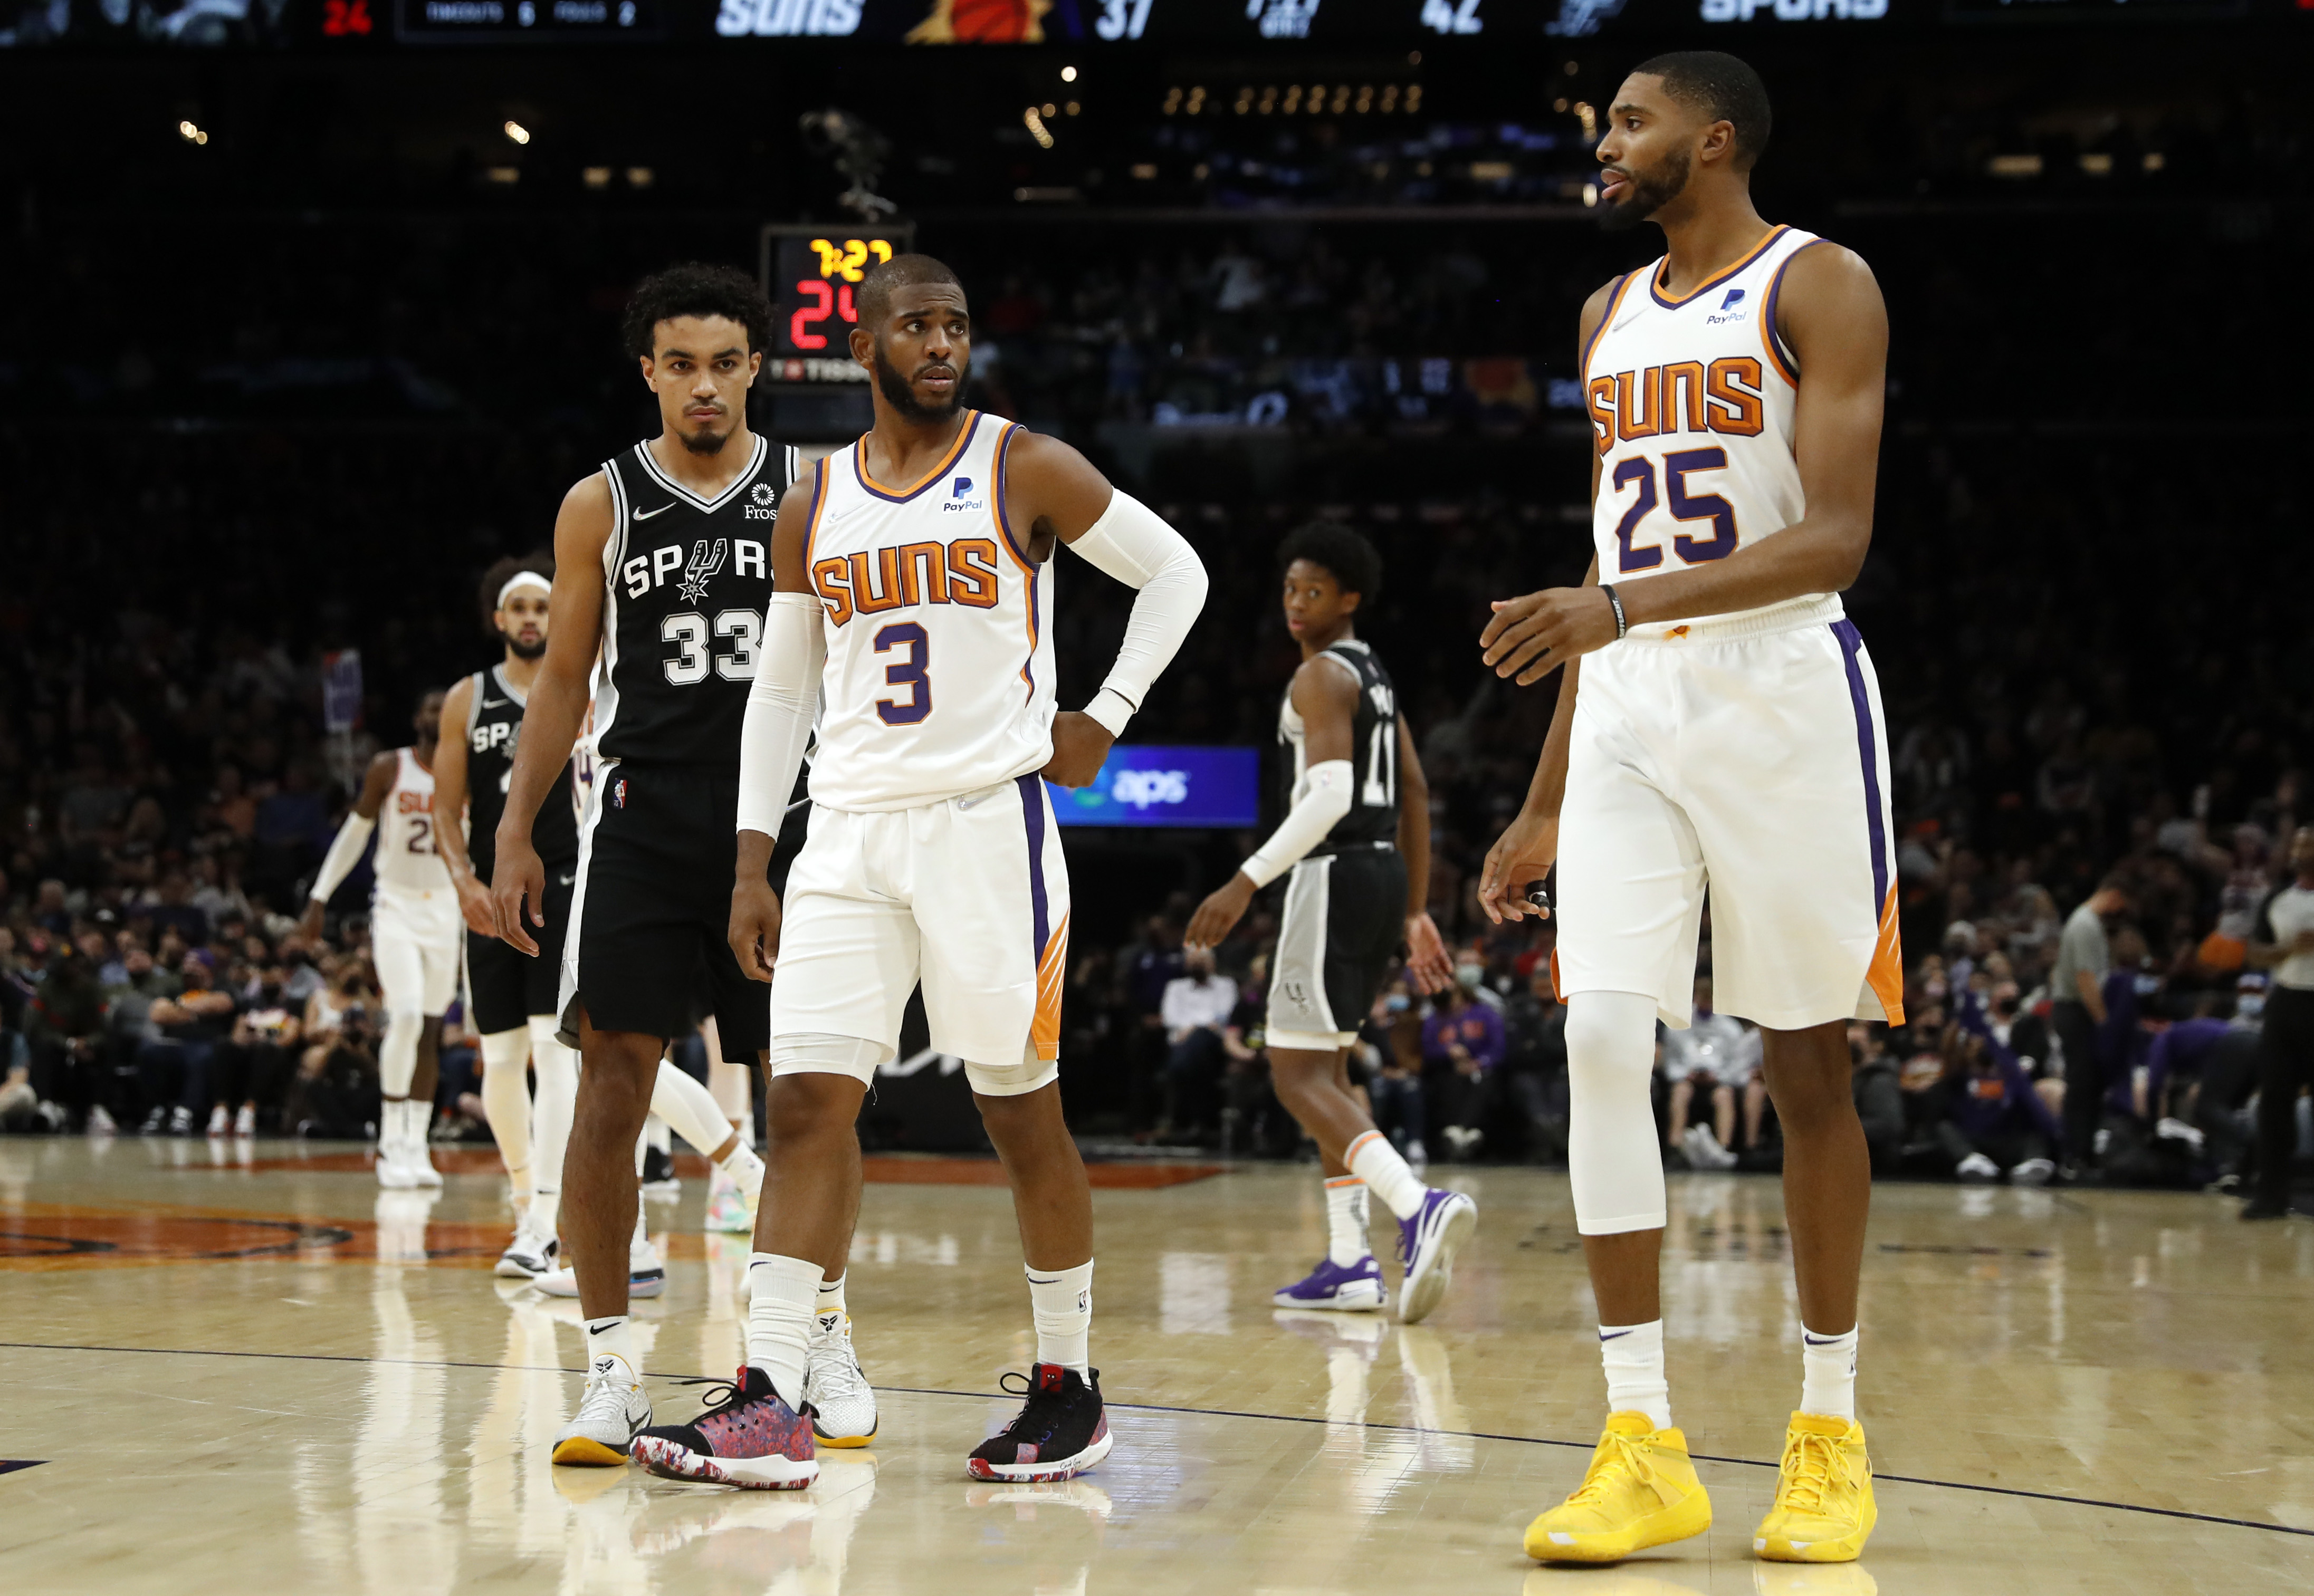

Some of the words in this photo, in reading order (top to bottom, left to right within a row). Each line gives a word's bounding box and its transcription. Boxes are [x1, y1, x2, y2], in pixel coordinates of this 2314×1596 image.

[809, 239, 893, 282] 7:27
[1706, 311, 1747, 324] PayPal
[1589, 356, 1764, 457] SUNS
[744, 505, 777, 520] Fros
[943, 500, 982, 512] PayPal
[1612, 446, 1739, 574] 25
[812, 538, 998, 628] SUNS
[661, 608, 764, 686] 33
[873, 621, 933, 727] 3
